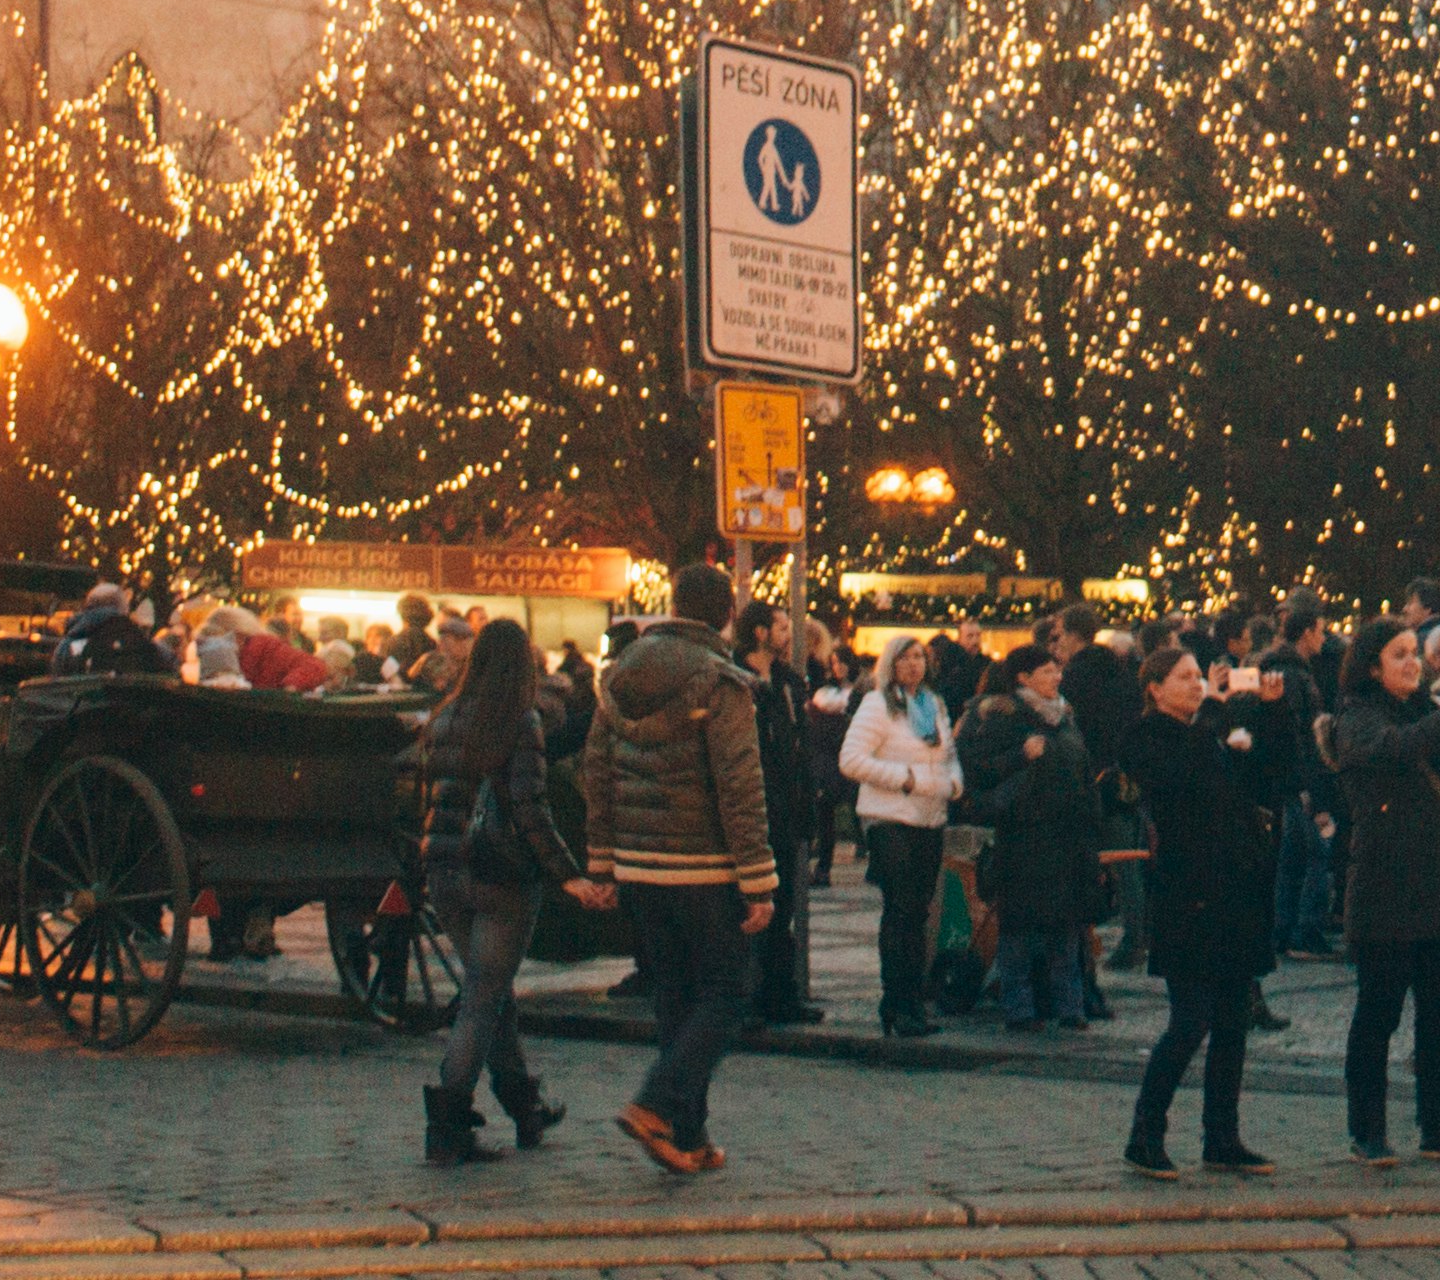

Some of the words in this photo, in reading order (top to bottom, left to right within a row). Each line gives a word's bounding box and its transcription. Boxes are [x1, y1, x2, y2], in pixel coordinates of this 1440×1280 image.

[722, 62, 770, 97] PĚŠÍ
[782, 76, 840, 115] ZÓNA
[738, 264, 767, 283] MIMO
[789, 252, 836, 275] OBSLUHA
[748, 287, 787, 311] SVATBY
[773, 335, 809, 357] PRAHA
[248, 565, 344, 585] CHICKEN
[349, 567, 429, 587] SKEWER
[475, 571, 593, 591] SAUSAGE
